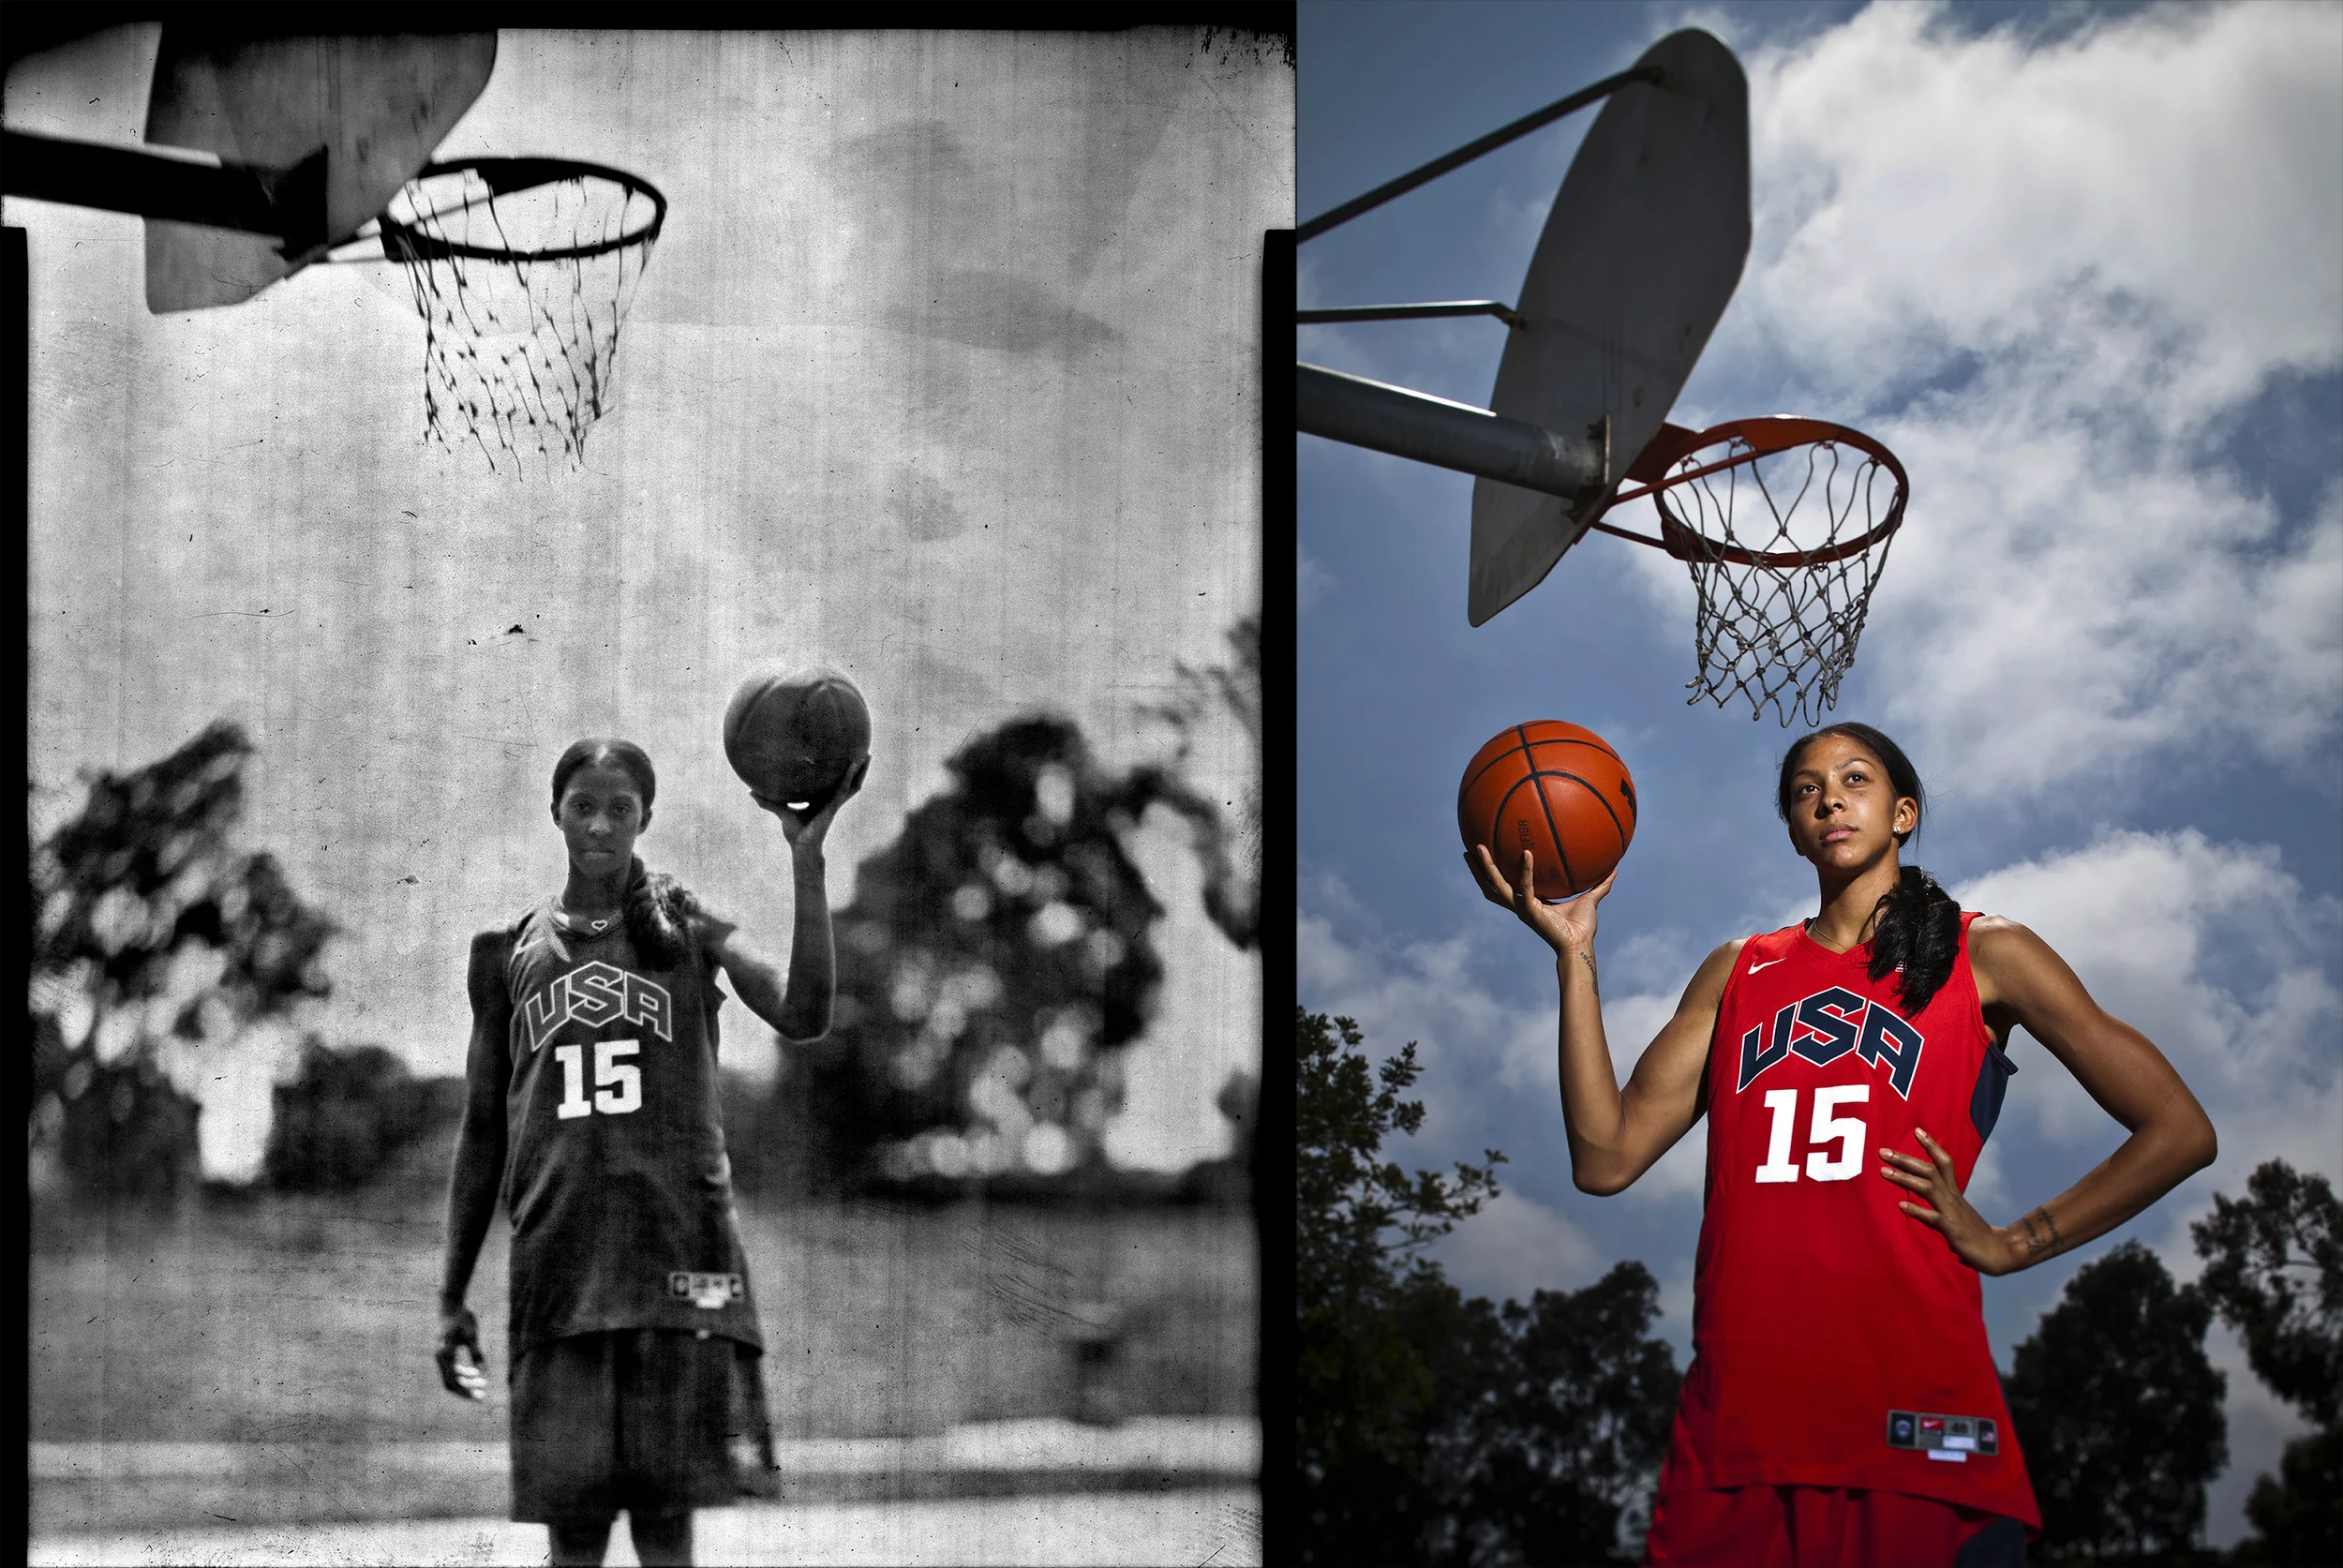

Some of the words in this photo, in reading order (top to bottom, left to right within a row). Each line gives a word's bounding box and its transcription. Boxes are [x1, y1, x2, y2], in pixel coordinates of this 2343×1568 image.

[526, 961, 672, 1052] USA
[1736, 986, 1924, 1101] USA
[556, 1039, 642, 1119] 15
[1755, 1084, 1870, 1183] 15
